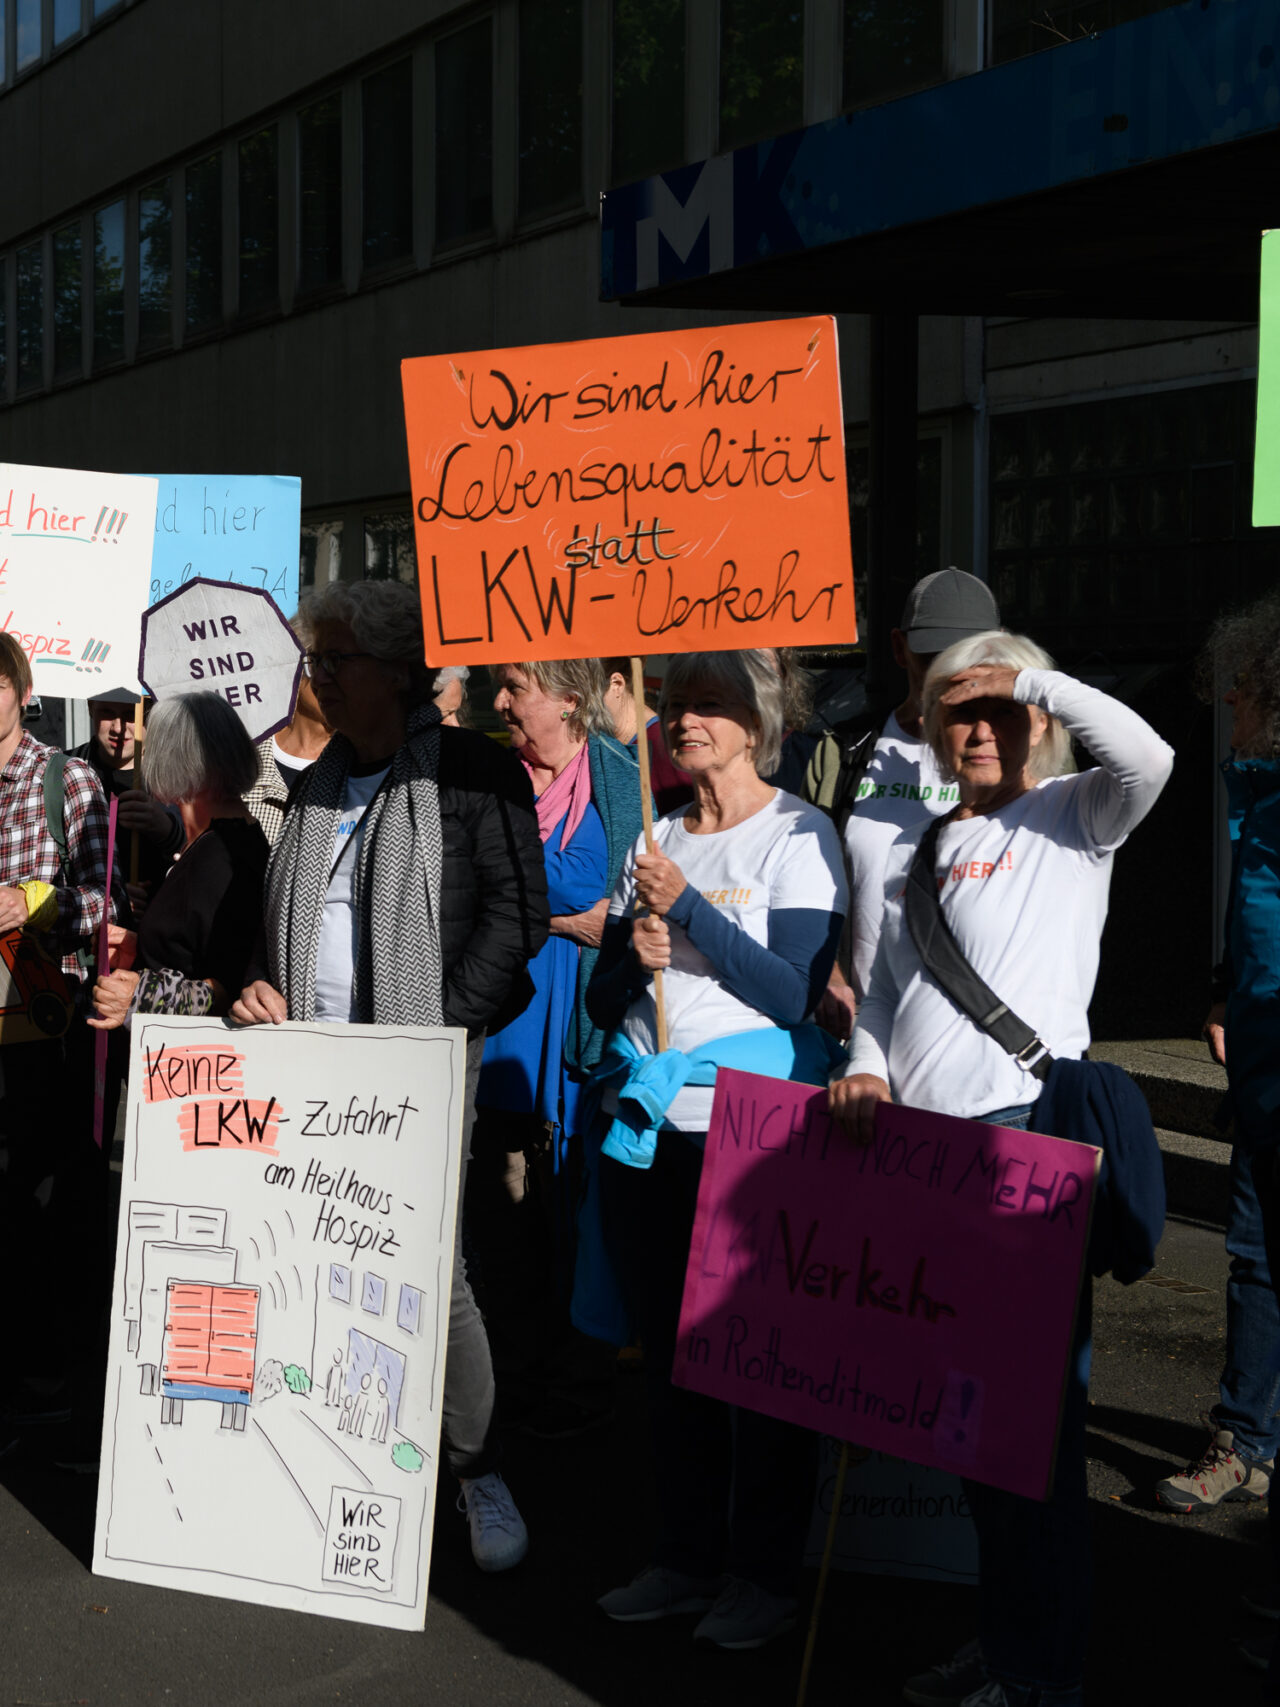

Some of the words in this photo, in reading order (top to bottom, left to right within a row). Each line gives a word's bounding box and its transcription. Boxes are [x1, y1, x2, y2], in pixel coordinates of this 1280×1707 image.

[470, 369, 569, 431] Wir
[573, 360, 678, 420] sind
[683, 350, 804, 410] hier
[417, 424, 836, 527] Lebensqualität
[203, 486, 266, 535] hier
[564, 516, 680, 569] statt
[183, 615, 242, 642] WIR
[189, 651, 255, 680] SIND
[215, 683, 263, 708] ER
[889, 781, 933, 801] SIND
[937, 786, 962, 802] HI
[145, 1042, 238, 1101] Keine
[718, 1089, 836, 1161] NICHT
[263, 1162, 296, 1190] am
[312, 1198, 402, 1262] Hospiz
[687, 1325, 711, 1365] in
